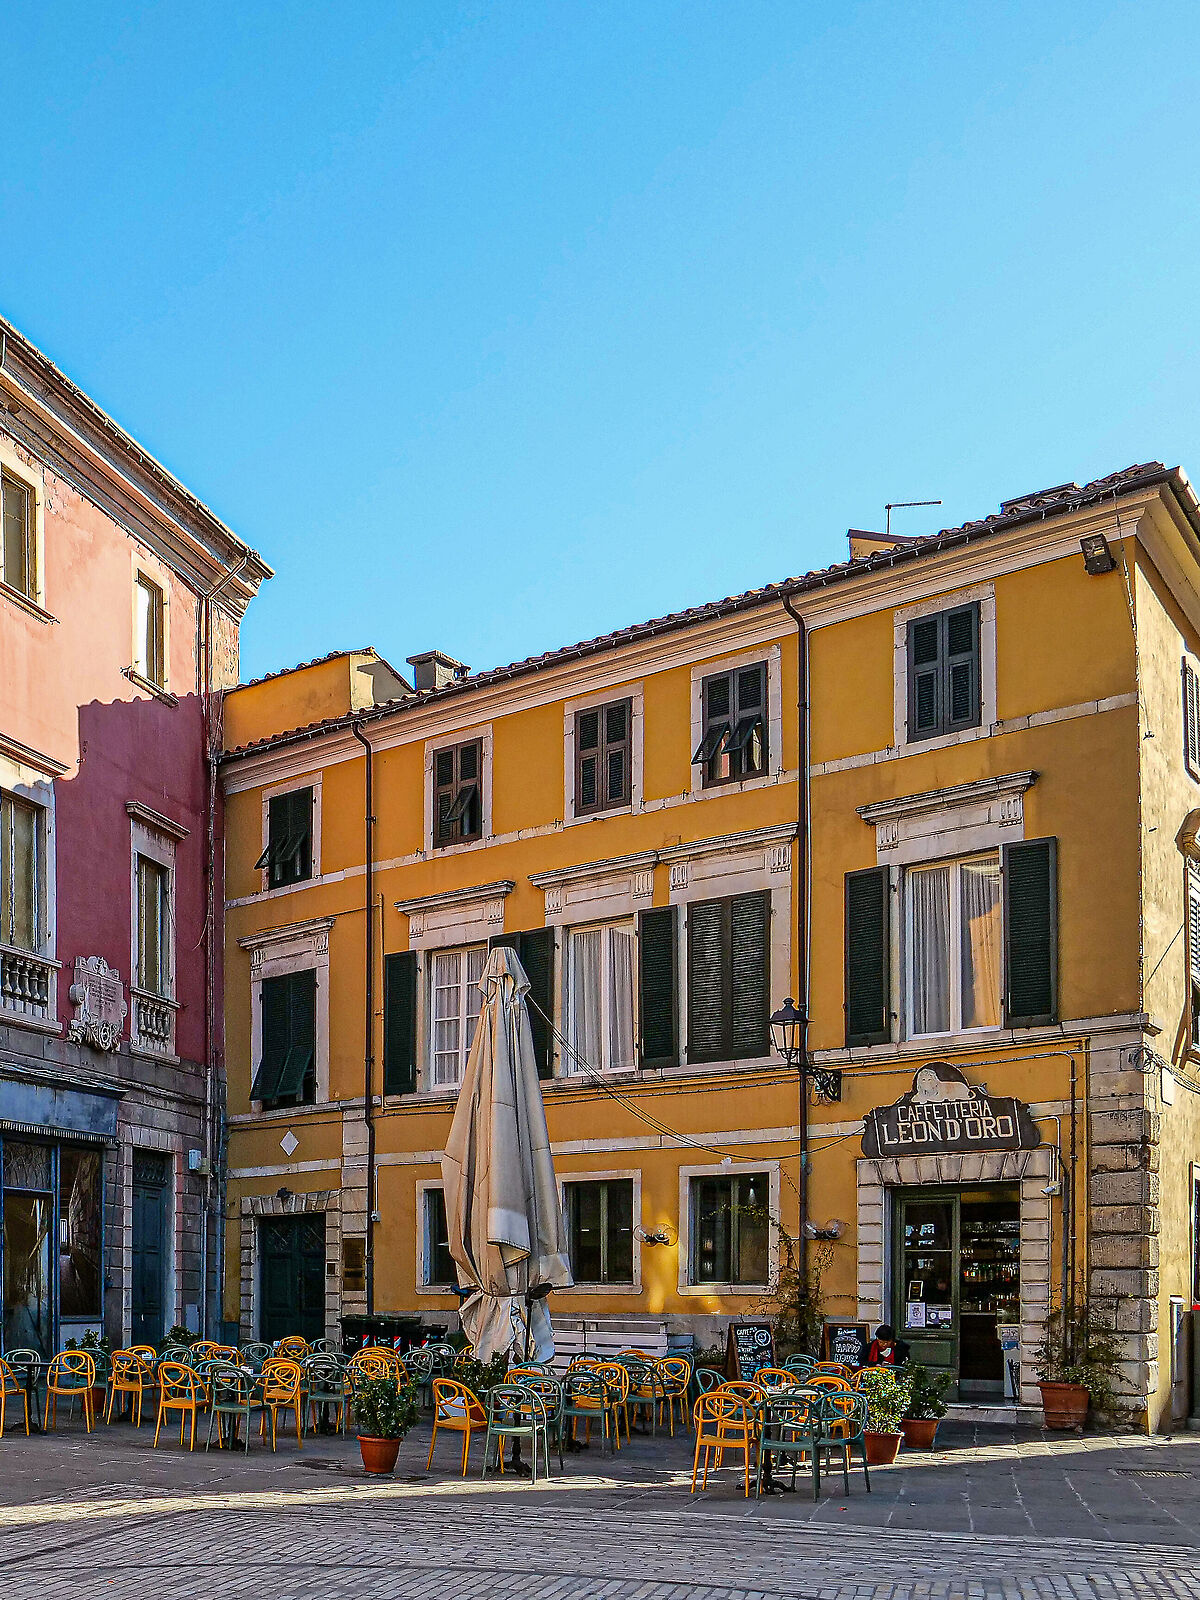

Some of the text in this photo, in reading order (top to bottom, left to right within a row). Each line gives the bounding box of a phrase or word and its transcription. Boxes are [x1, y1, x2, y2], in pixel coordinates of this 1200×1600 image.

[897, 1099, 993, 1123] CAFFETTERIA
[882, 1115, 1014, 1146] LEON D'ORO
[835, 1343, 861, 1354] HAPPY
